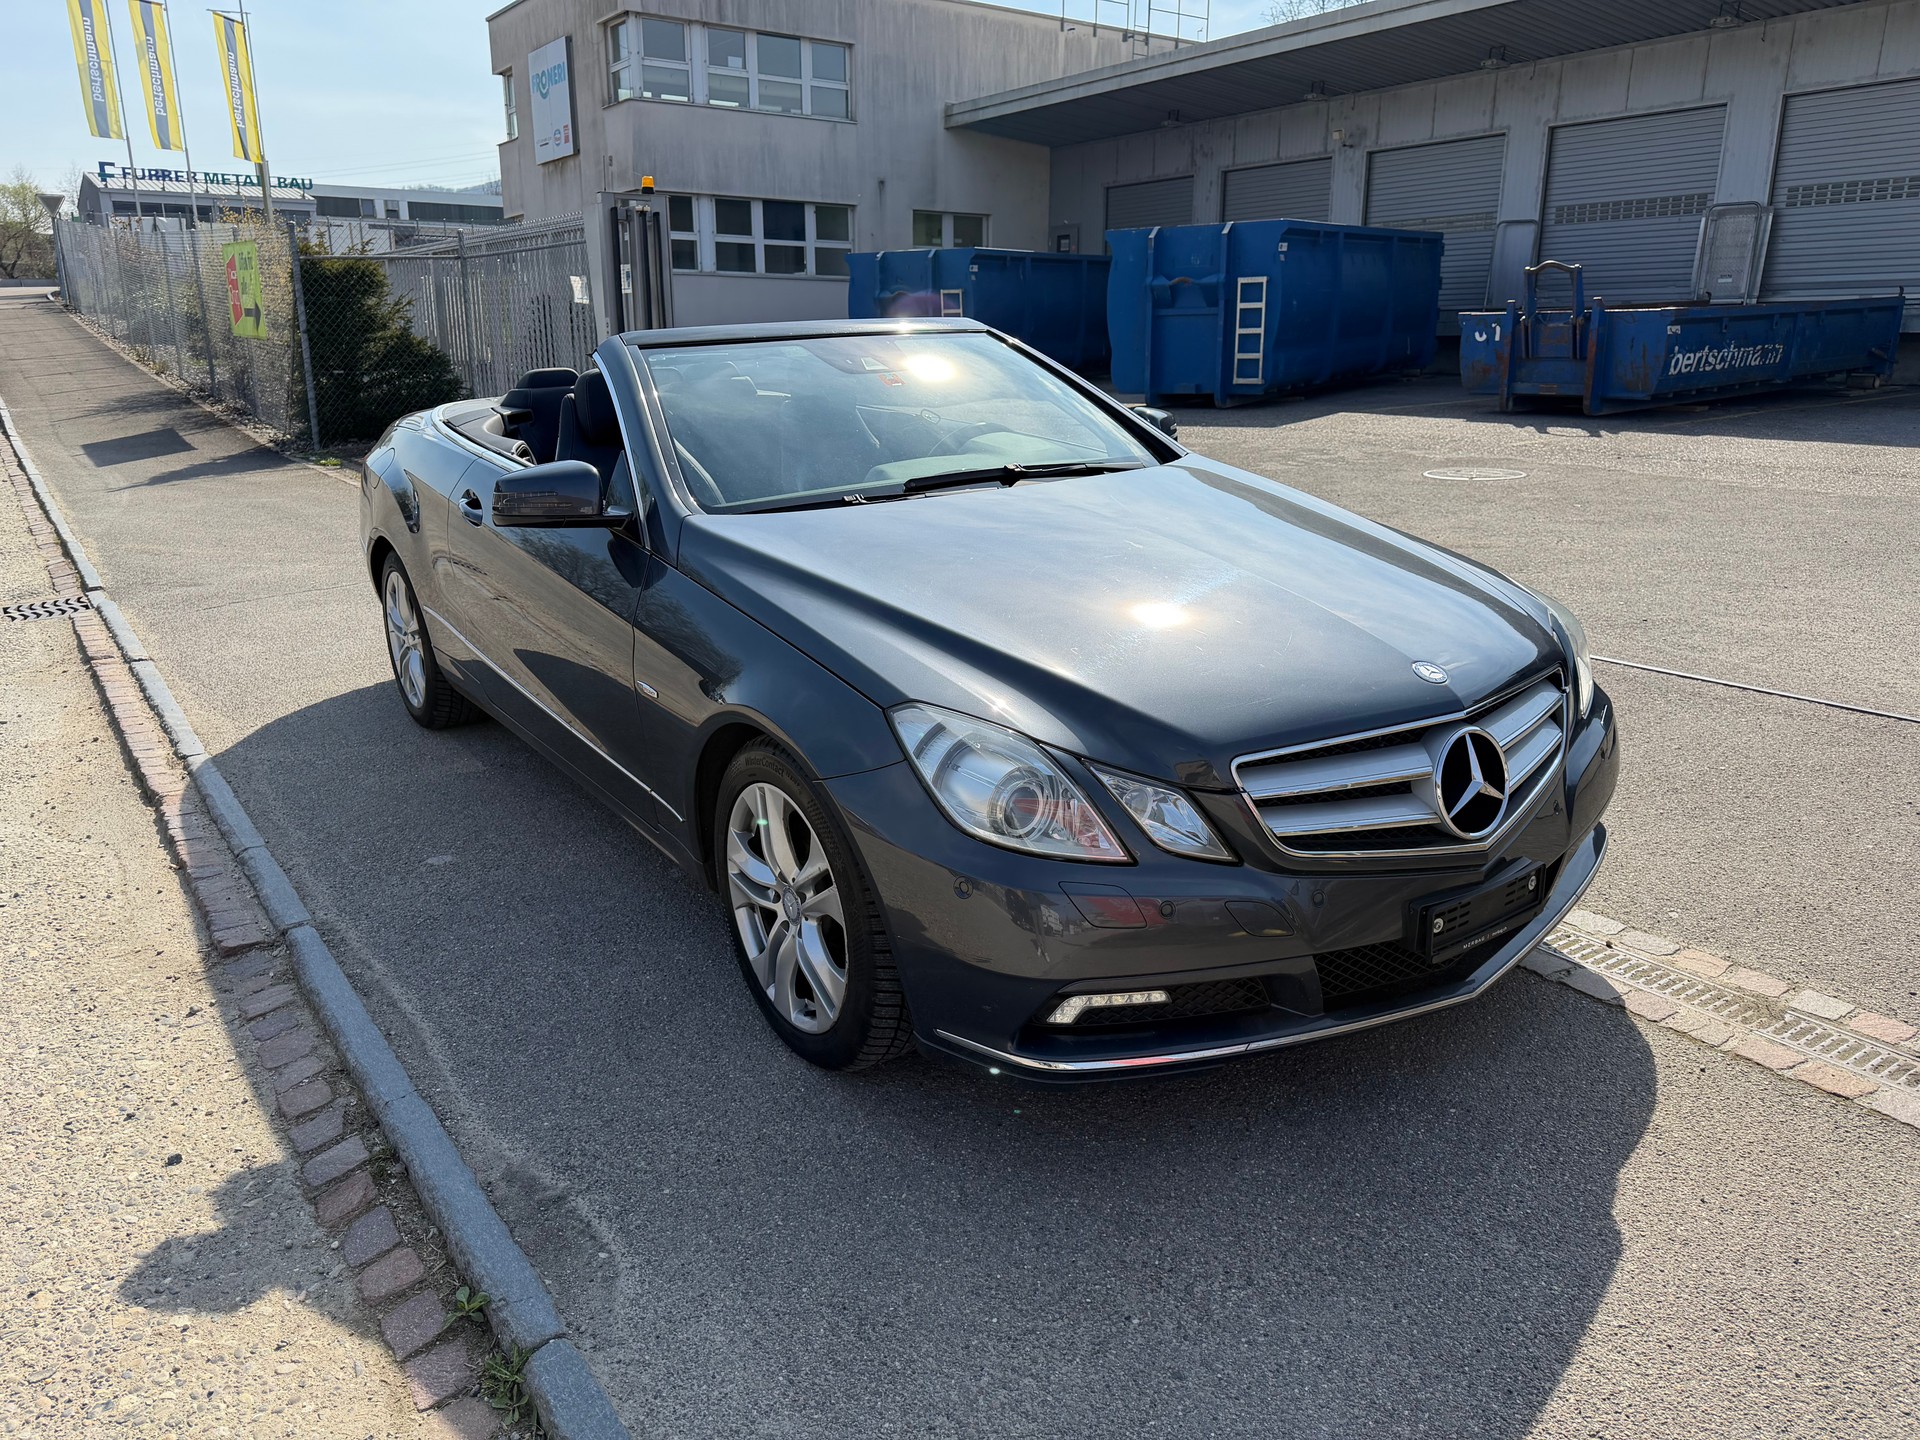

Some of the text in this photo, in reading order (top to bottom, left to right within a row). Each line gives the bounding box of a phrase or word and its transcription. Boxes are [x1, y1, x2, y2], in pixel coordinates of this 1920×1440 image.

[531, 61, 566, 98] FRONERI
[121, 166, 198, 183] FURRER
[203, 171, 314, 190] METALBAU
[744, 756, 785, 777] WinterContact
